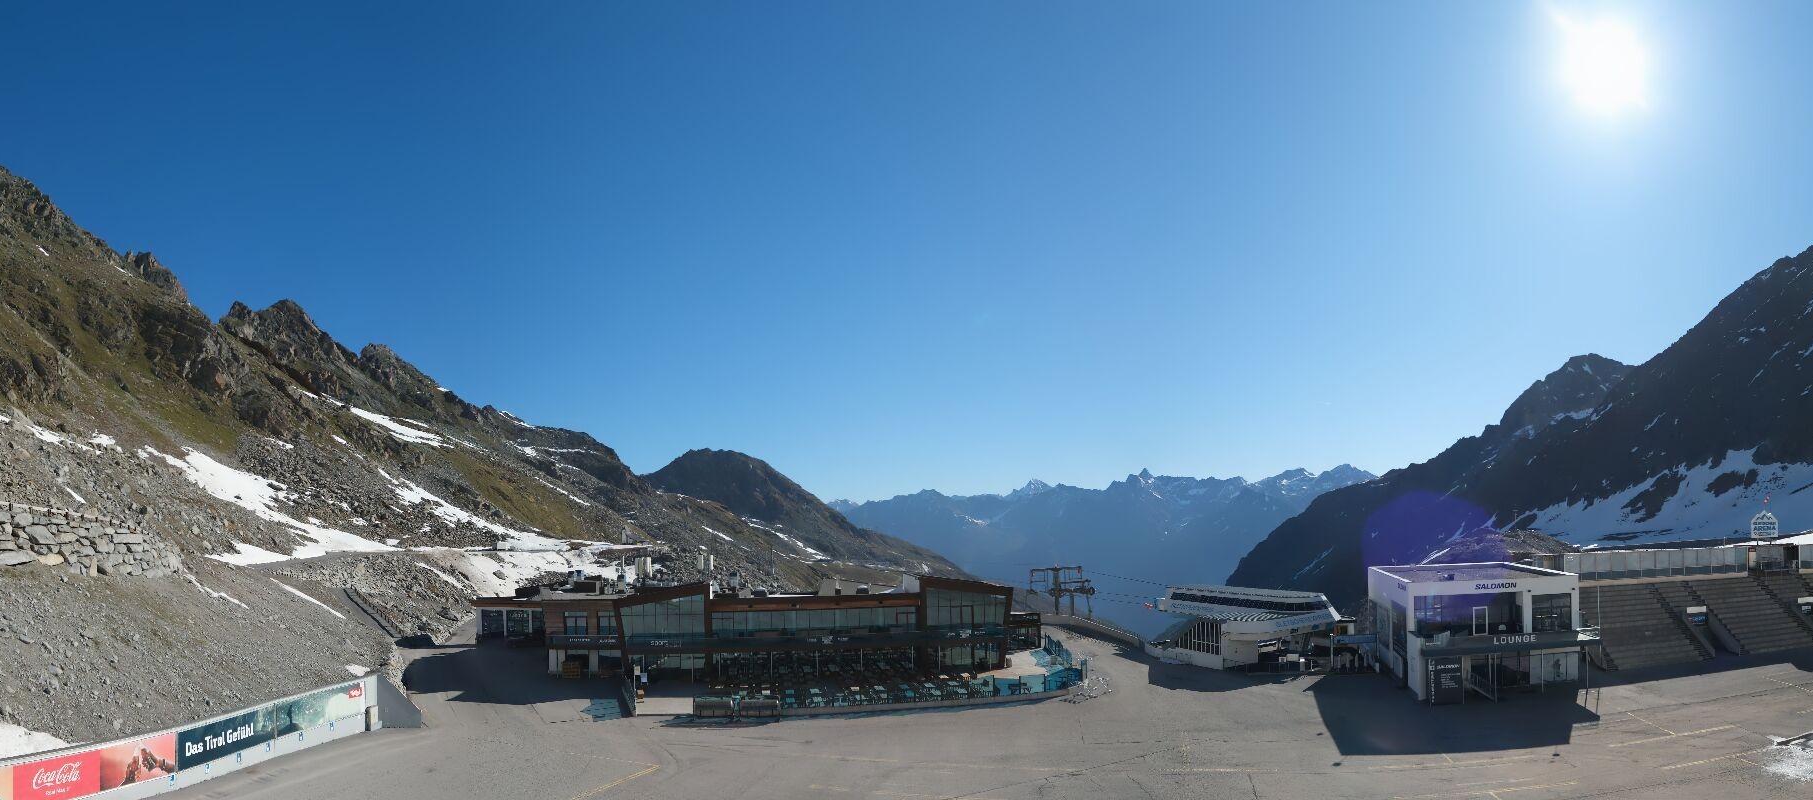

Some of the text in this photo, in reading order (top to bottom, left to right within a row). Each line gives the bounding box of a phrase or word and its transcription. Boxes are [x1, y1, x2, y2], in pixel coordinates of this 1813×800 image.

[1475, 582, 1517, 590] SALOMON
[1493, 634, 1537, 645] LOUNGE
[185, 722, 255, 757] Das Tirol Gefühl
